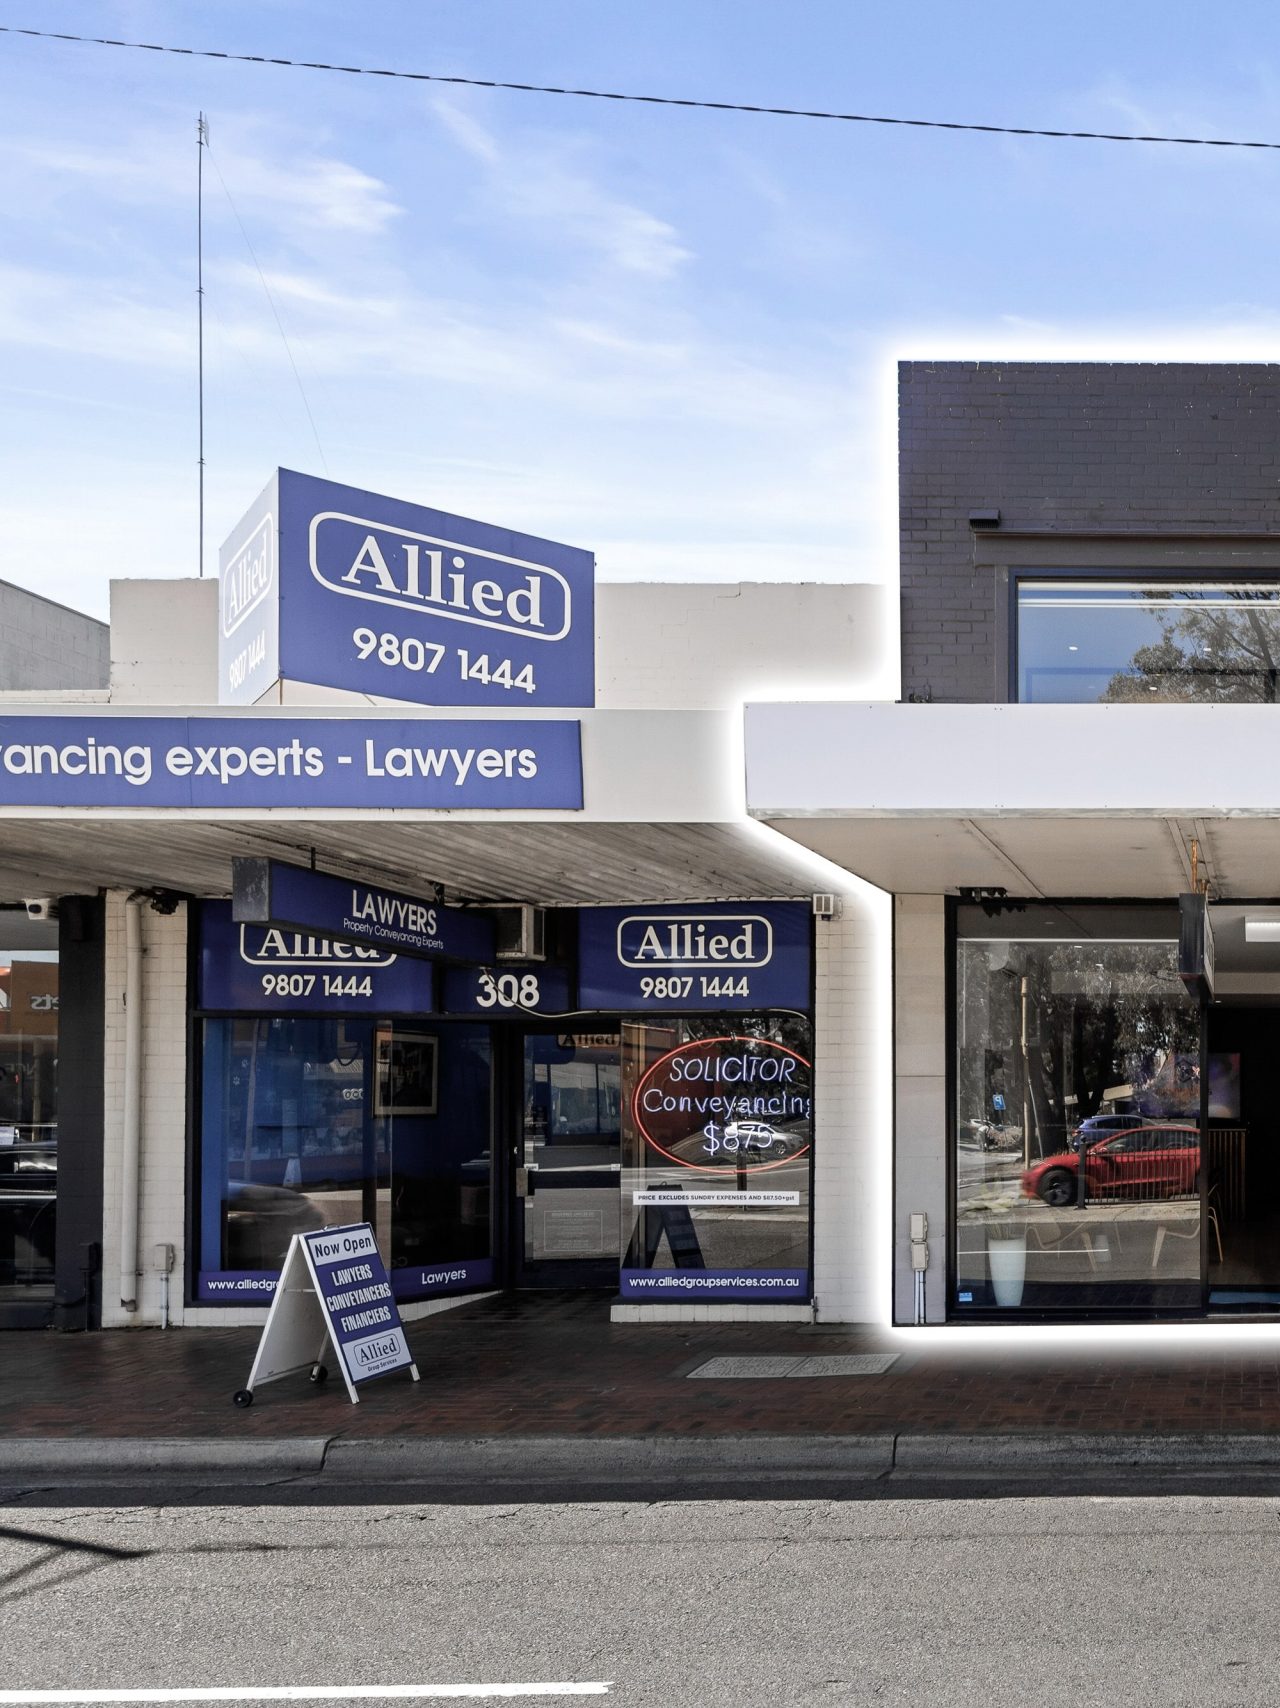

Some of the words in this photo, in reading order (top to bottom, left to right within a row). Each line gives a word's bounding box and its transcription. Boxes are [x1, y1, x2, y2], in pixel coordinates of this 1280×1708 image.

[228, 528, 268, 625] Allied
[341, 534, 545, 630] Allied
[229, 651, 247, 692] 9807
[248, 630, 266, 675] 1444
[352, 627, 446, 674] 9807
[457, 649, 536, 694] 1444
[0, 737, 152, 785] ancing
[165, 738, 325, 784] experts
[337, 756, 352, 765] -
[365, 739, 538, 786] Lawyers
[352, 889, 437, 936] LAWYERS
[343, 917, 374, 936] Property
[374, 925, 422, 947] Conveyancing
[422, 936, 444, 949] Experts
[634, 923, 755, 960] Allied
[262, 974, 316, 996] 9807
[323, 975, 373, 997] 1444
[476, 974, 540, 1008] 308
[640, 977, 693, 999] 9807
[700, 976, 750, 998] 1444
[669, 1054, 796, 1082] SOLICITOR
[703, 1120, 773, 1156] $875
[315, 1243, 340, 1258] Now
[343, 1237, 372, 1253] Open
[331, 1263, 373, 1287] LAWYERS
[421, 1268, 467, 1285] Lawyers
[629, 1276, 800, 1289] www.alliedgroupservices.com.au
[326, 1282, 392, 1312] CONVEYANCERS
[340, 1305, 392, 1333] FINANCIERS
[360, 1338, 397, 1363] Allied
[367, 1363, 380, 1372] Group
[380, 1358, 397, 1368] Services
